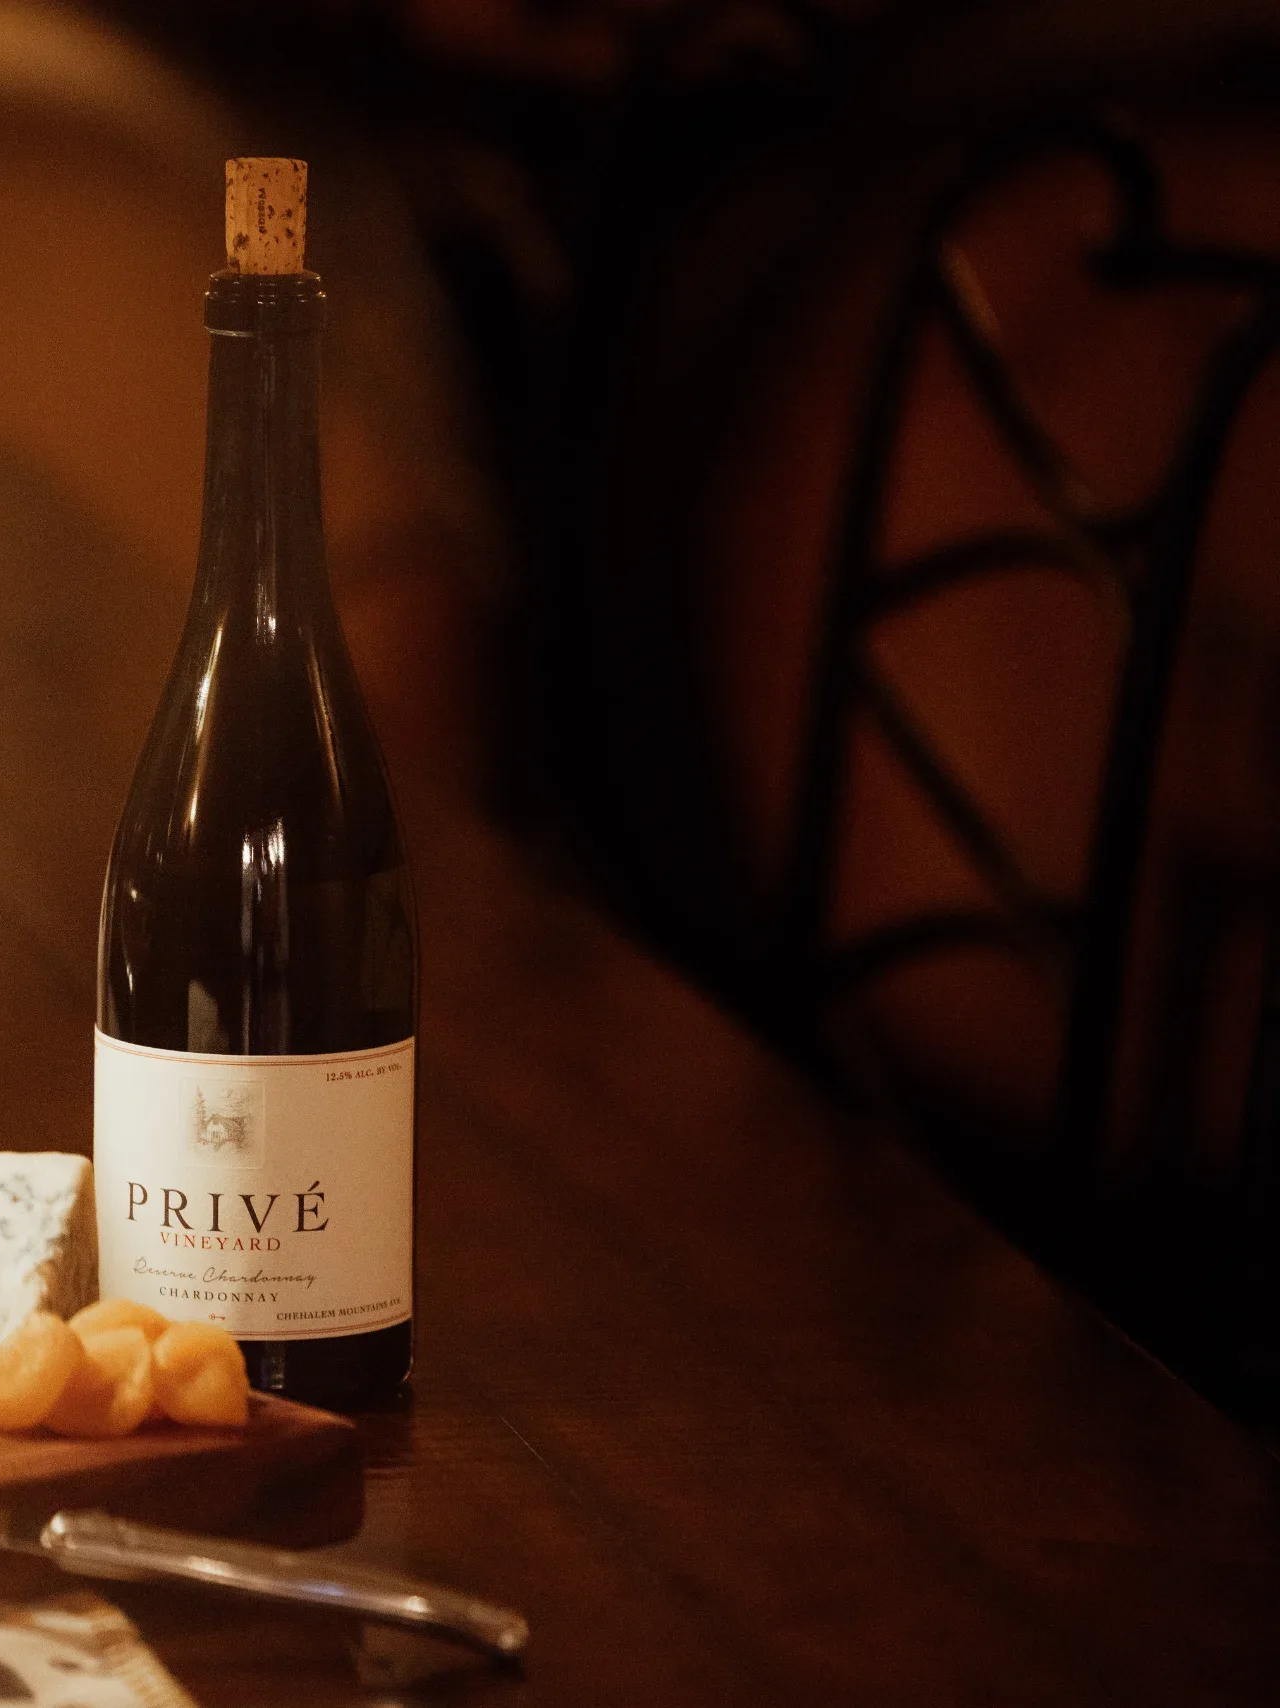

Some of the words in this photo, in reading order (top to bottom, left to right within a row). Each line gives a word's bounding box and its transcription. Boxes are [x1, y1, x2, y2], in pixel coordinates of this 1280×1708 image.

[325, 1070, 353, 1082] 12.5%
[355, 1069, 375, 1080] ALC.
[376, 1066, 387, 1077] BY
[125, 1180, 330, 1234] PRIVÉ
[160, 1231, 282, 1252] VINEYARD
[133, 1256, 196, 1281] Reserve
[202, 1266, 318, 1288] Chardonnay
[159, 1286, 280, 1303] CHARDONNAY
[276, 1309, 337, 1321] CHEHALEM
[338, 1299, 389, 1317] MOUNTAINS
